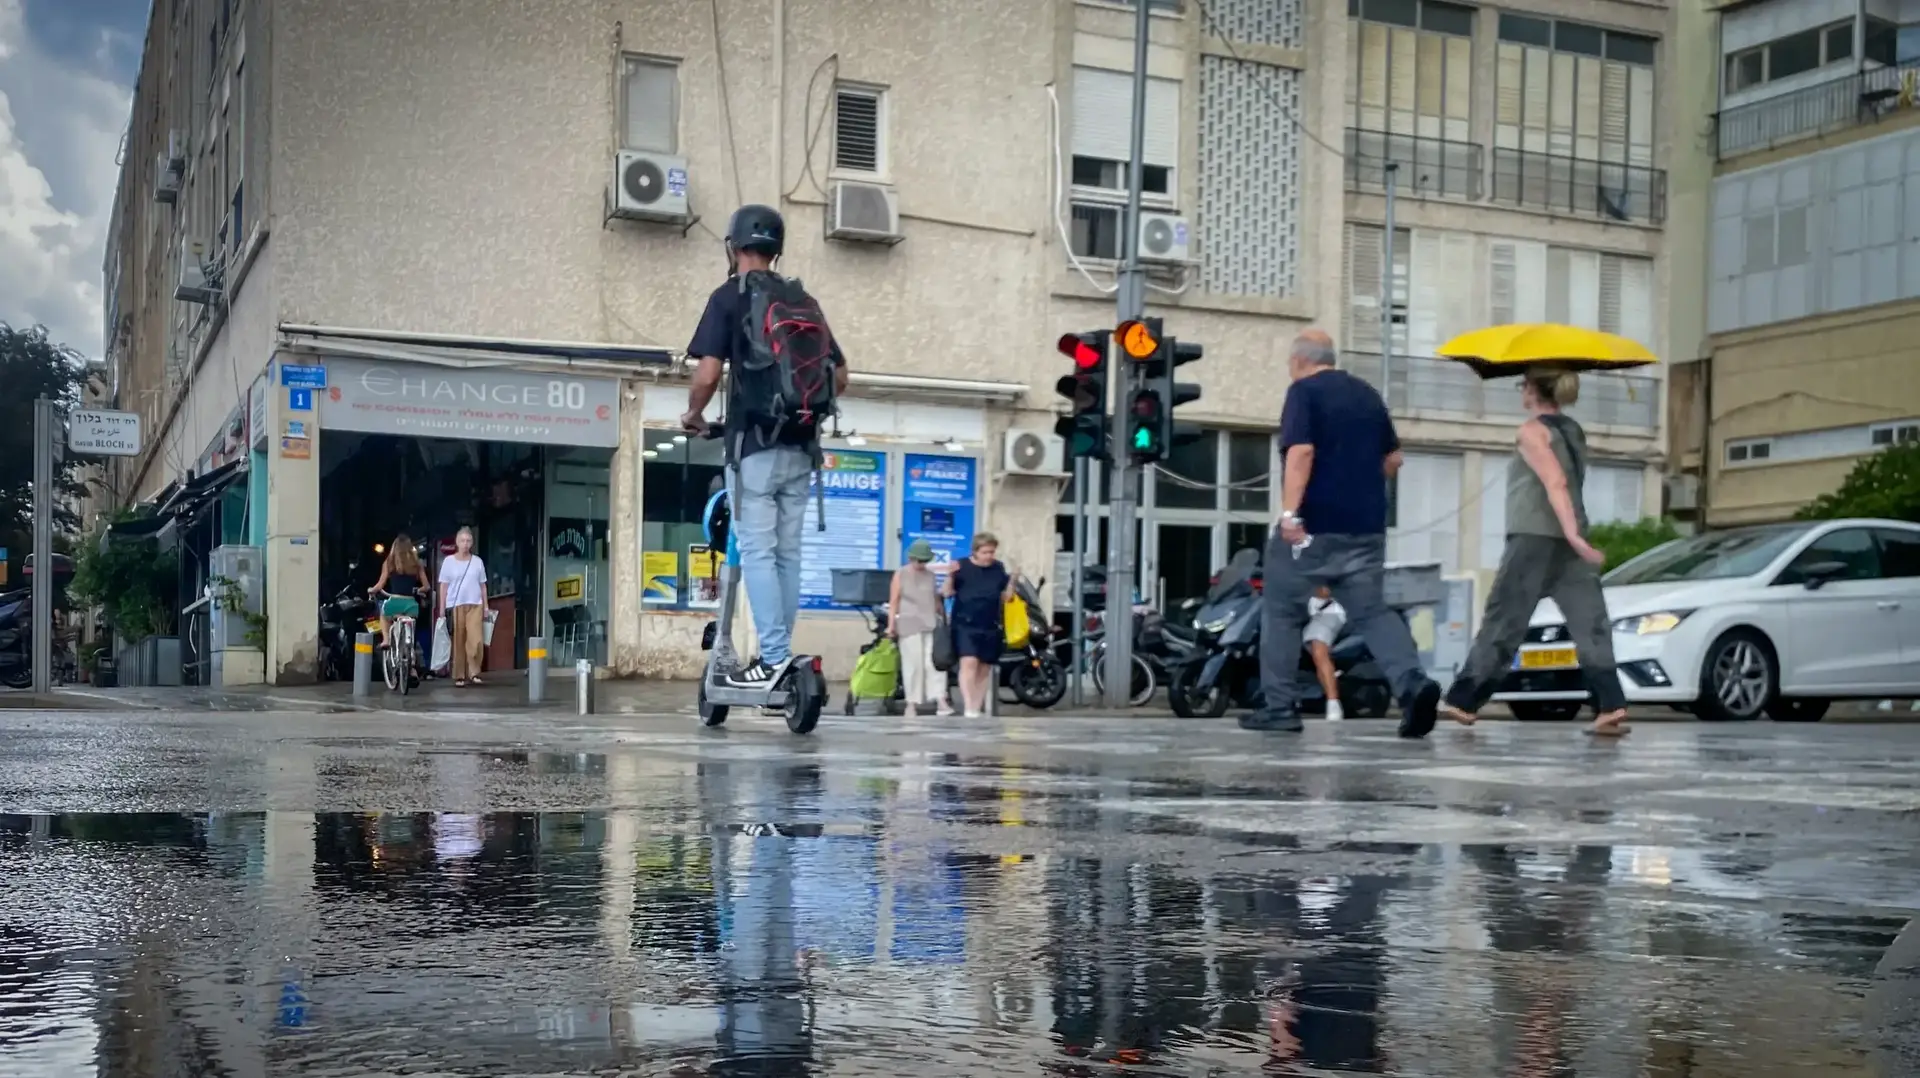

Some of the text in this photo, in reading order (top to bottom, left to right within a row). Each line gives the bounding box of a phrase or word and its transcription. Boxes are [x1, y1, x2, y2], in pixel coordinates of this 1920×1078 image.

[296, 393, 304, 406] 1
[547, 380, 586, 410] 80
[76, 413, 101, 424] בלוך
[95, 440, 124, 448] BLOCH
